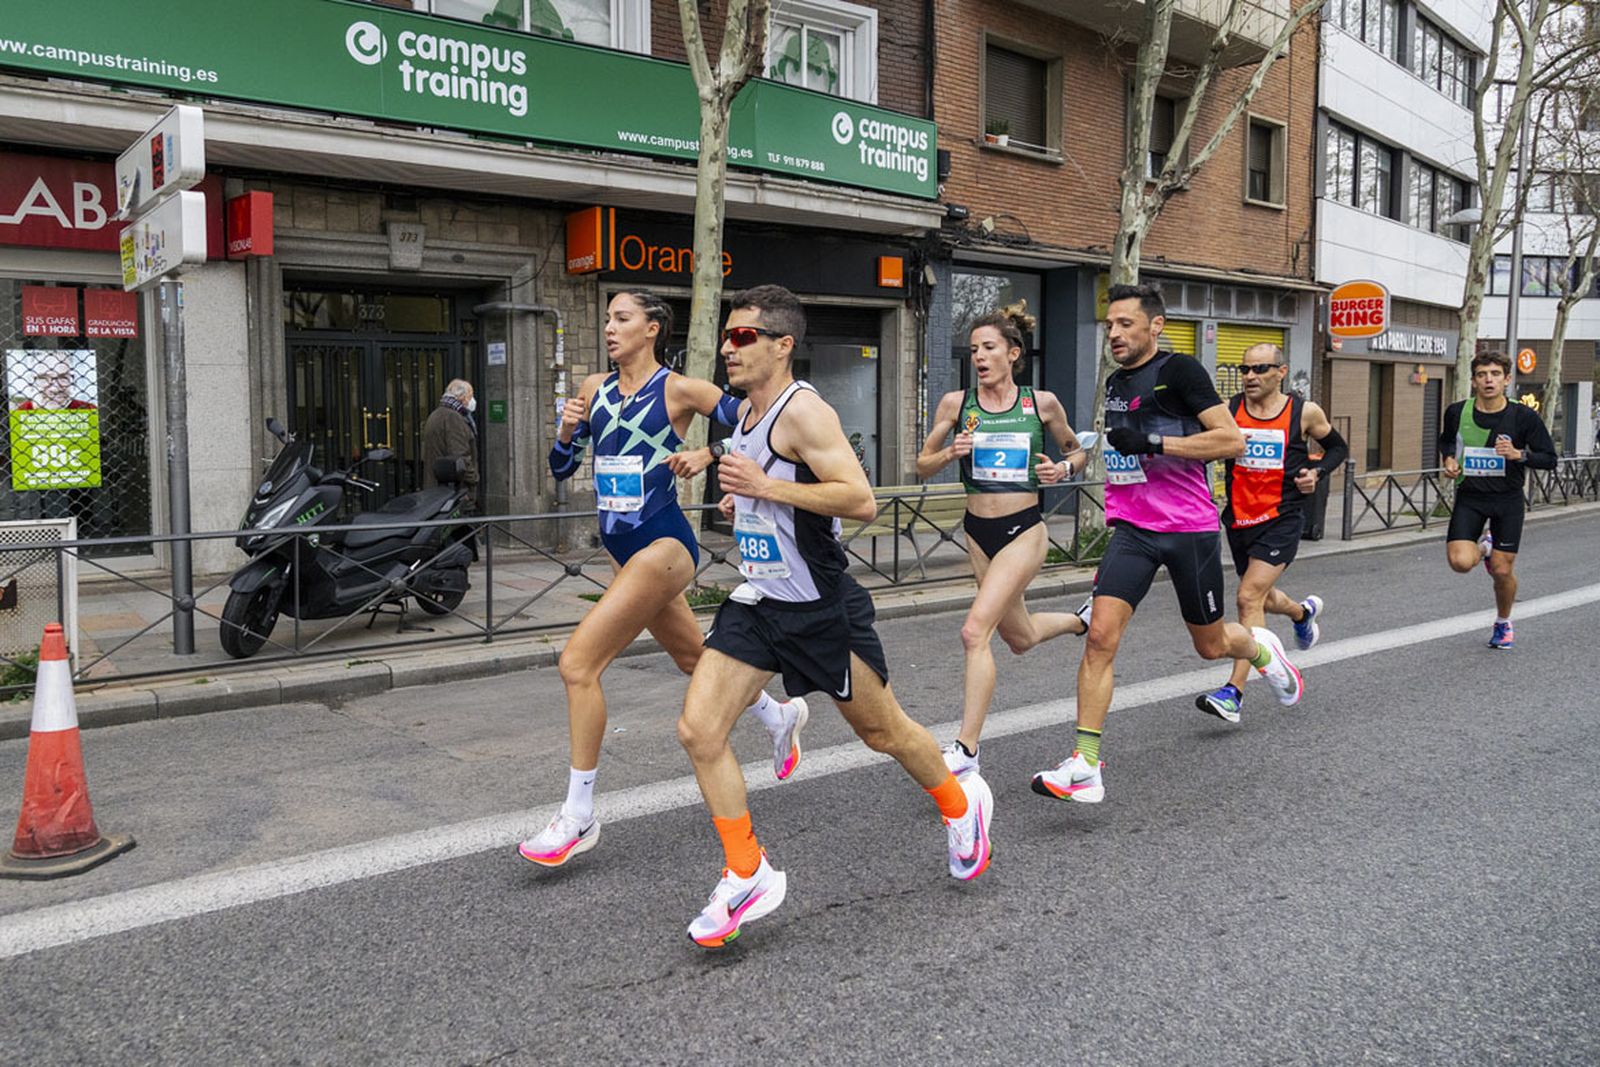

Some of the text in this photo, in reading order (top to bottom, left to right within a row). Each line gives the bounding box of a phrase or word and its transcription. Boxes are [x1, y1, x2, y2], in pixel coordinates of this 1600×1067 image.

[398, 31, 527, 77] campus
[398, 59, 528, 117] training
[859, 118, 928, 152] campus
[617, 130, 754, 160] www.campustng.es
[767, 152, 781, 163] TLF
[859, 139, 928, 182] training
[0, 175, 109, 231] AB
[568, 255, 595, 270] orange
[620, 235, 732, 277] Orane
[358, 303, 386, 321] 373
[1331, 299, 1384, 312] BURGER
[26, 316, 76, 326] SUS GAFAS
[1330, 310, 1384, 327] KING
[26, 325, 39, 333] EN
[49, 326, 76, 334] HORA
[88, 327, 99, 335] DE
[101, 327, 111, 335] LA
[994, 451, 1007, 467] 2
[1104, 453, 1136, 470] 2030
[1470, 458, 1498, 469] 1110
[610, 477, 617, 494] 1
[739, 536, 770, 559] 488
